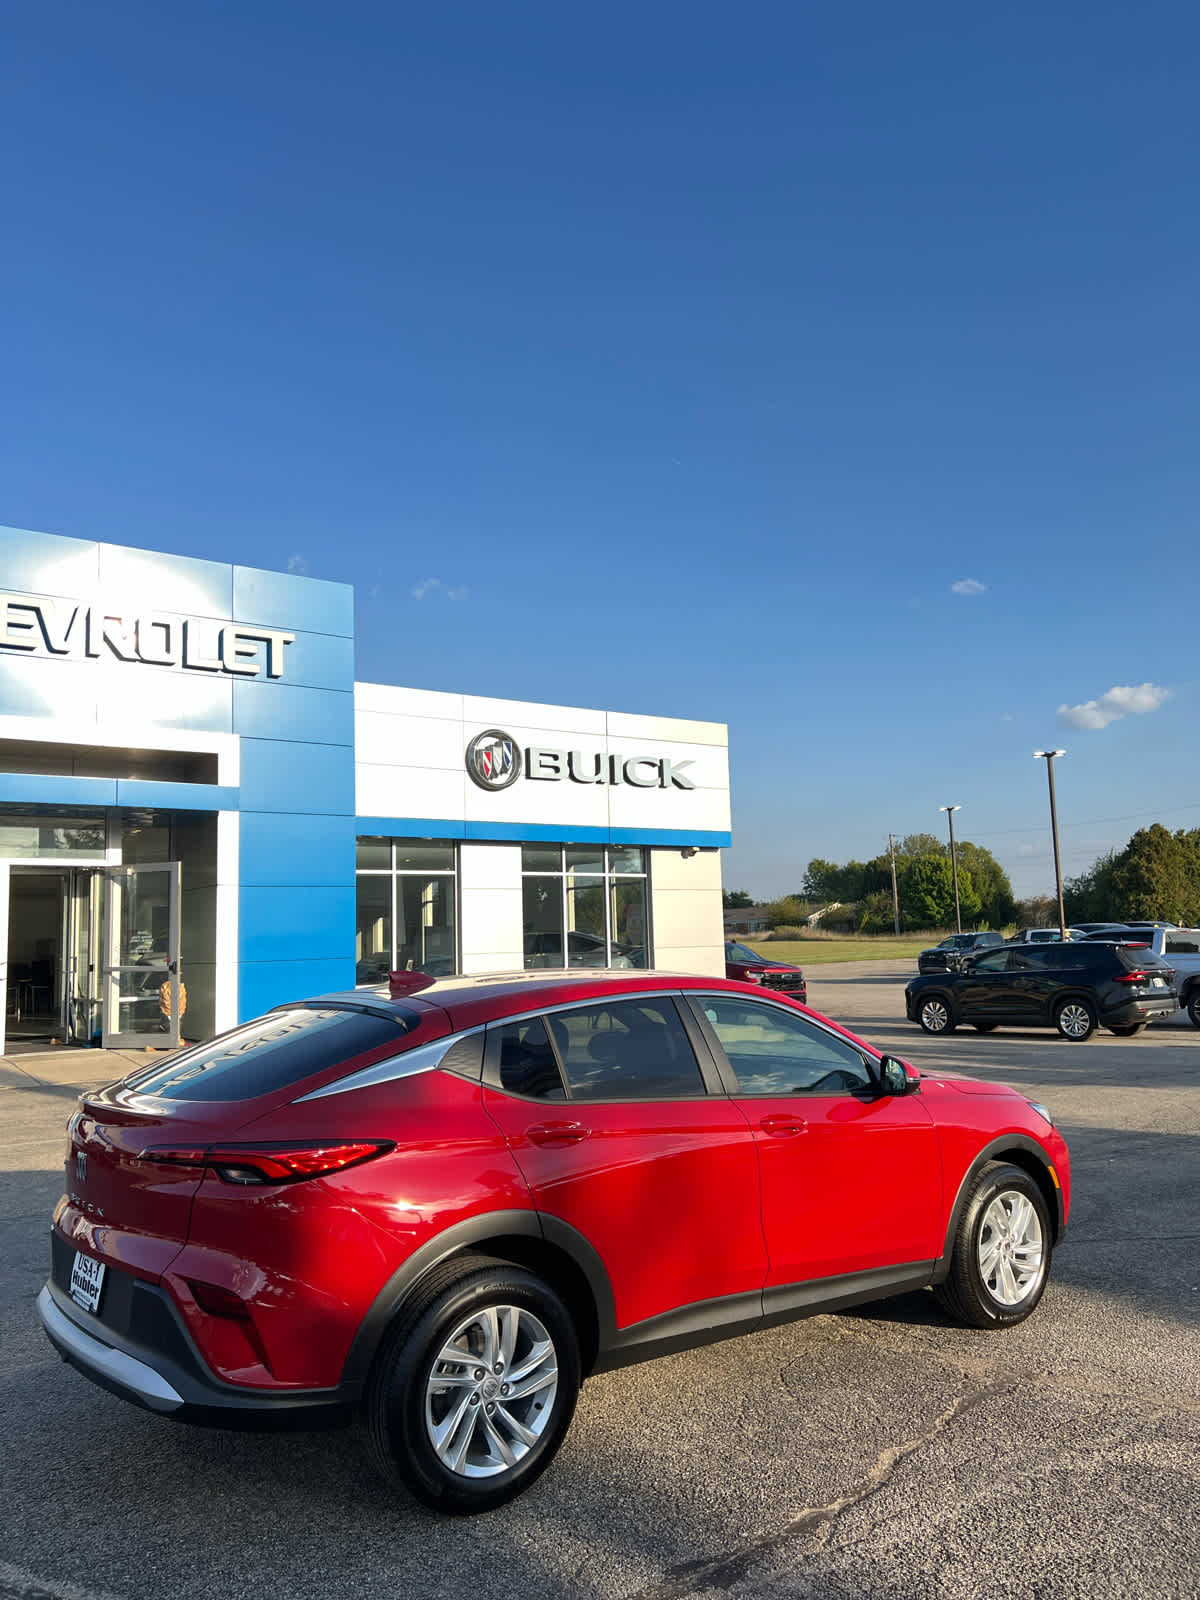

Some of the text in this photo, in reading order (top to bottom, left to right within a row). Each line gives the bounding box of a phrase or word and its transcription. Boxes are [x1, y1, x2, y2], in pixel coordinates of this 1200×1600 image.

[0, 595, 296, 679] EVROLET
[524, 747, 696, 790] BUICK
[73, 1269, 99, 1300] Hubler
